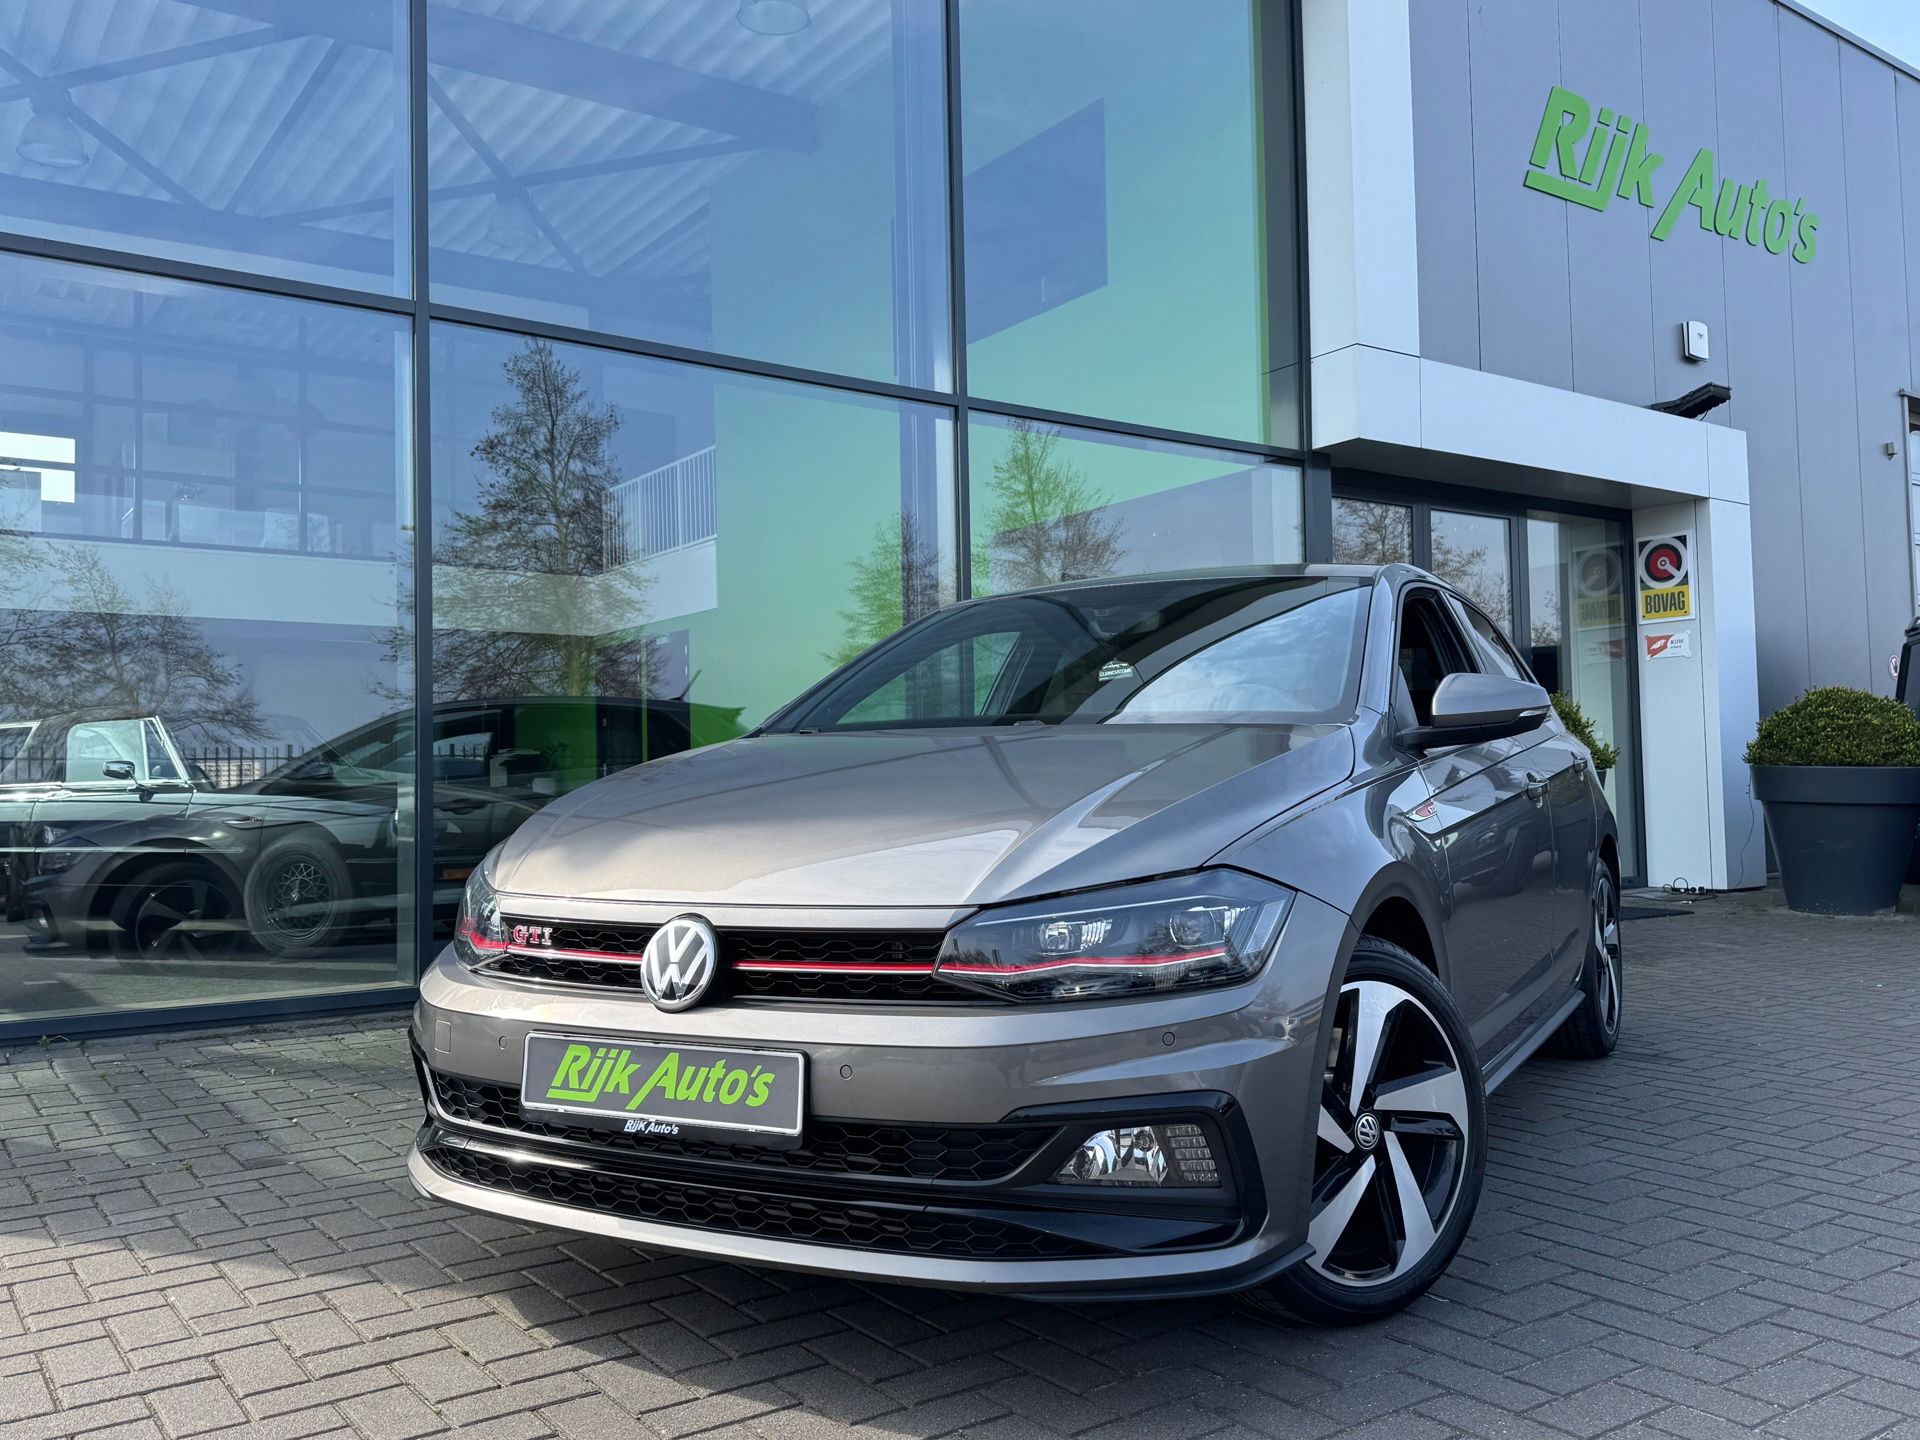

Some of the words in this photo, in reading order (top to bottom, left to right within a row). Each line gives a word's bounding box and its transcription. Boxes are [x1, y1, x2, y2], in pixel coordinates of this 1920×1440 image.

[1523, 86, 1665, 212] Rijk
[1650, 147, 1821, 264] Auto's
[1645, 590, 1686, 614] BOVAG
[513, 925, 553, 945] GTI
[545, 1043, 641, 1103] Rijk
[625, 1052, 775, 1110] Auto's
[645, 1122, 680, 1135] Auto's
